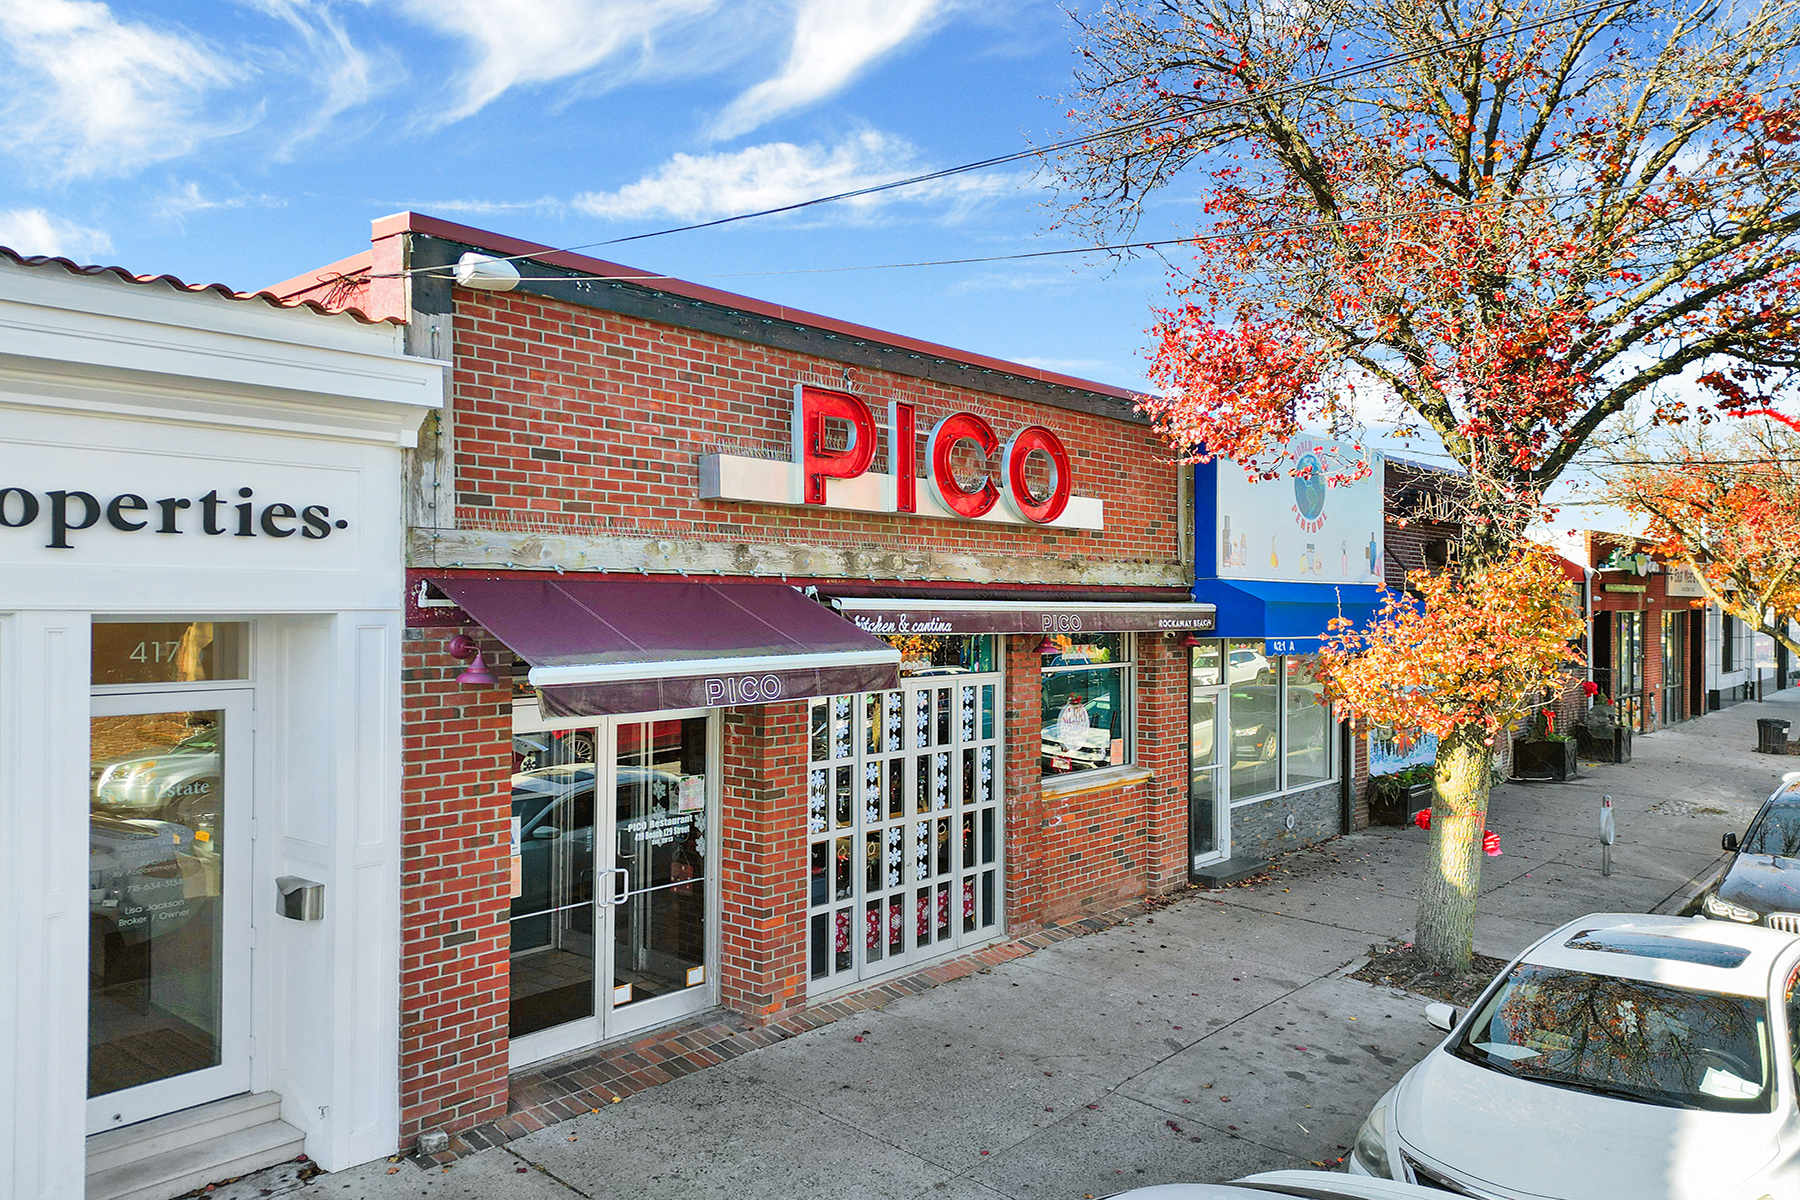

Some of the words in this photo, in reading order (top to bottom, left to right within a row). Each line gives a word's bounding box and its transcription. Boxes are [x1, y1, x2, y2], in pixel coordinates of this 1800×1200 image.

[792, 384, 1072, 525] PICO
[1291, 504, 1328, 533] PERFUME
[898, 613, 910, 632] &
[911, 617, 952, 632] cantina
[1041, 614, 1082, 631] PICO
[1158, 619, 1192, 628] ROCKAWAY
[1193, 619, 1212, 628] BEACH
[129, 641, 180, 663] 417
[1273, 641, 1287, 651] 421
[1289, 641, 1296, 651] A
[705, 674, 782, 706] PICO
[154, 781, 210, 799] Estate
[627, 821, 647, 833] PICO
[649, 815, 693, 829] Restaurant
[673, 825, 690, 835] Street
[157, 837, 193, 847] SATUDAY
[126, 878, 183, 893] 718-634-3134
[125, 906, 142, 915] Lisa
[146, 899, 185, 912] Jackson
[119, 915, 147, 927] Broker
[159, 908, 190, 920] Owner
